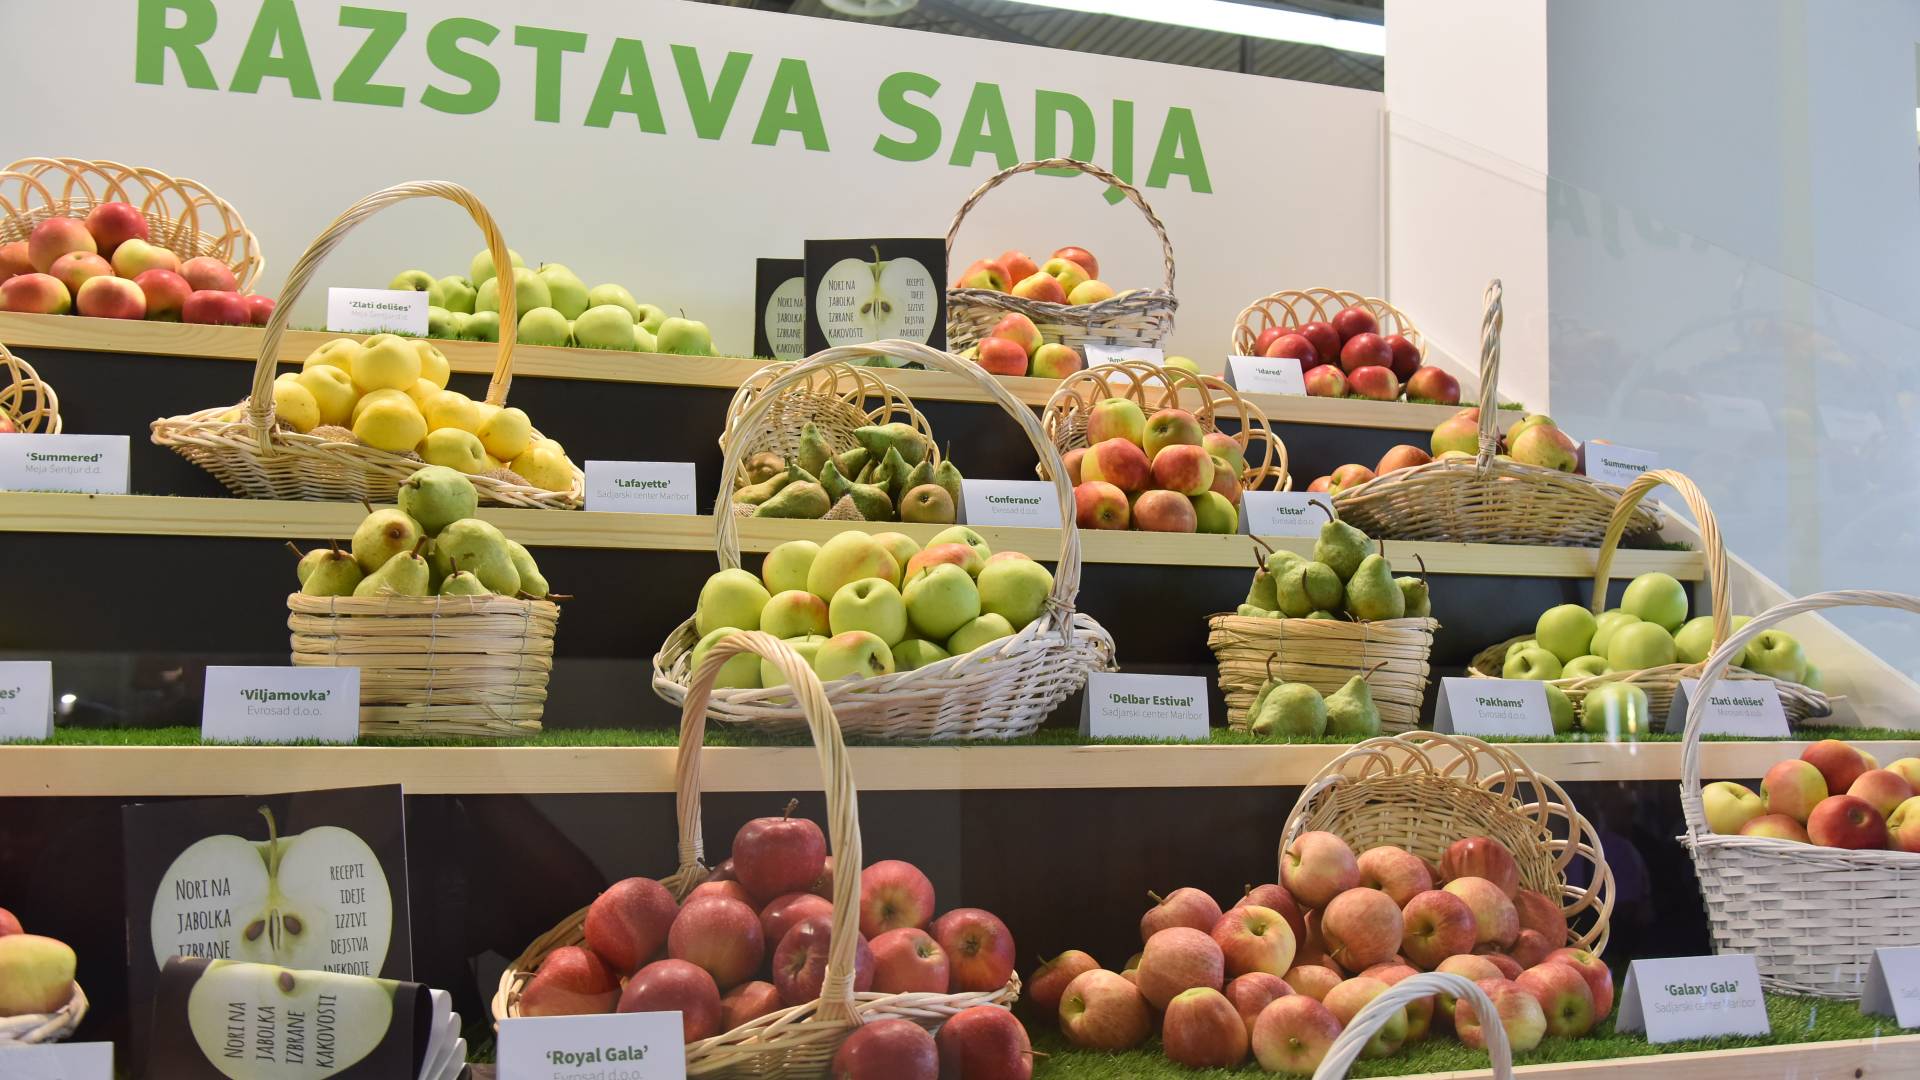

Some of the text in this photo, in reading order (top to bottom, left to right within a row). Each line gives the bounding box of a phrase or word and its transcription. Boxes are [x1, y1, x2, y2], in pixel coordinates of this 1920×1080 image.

[135, 0, 1213, 206] RAZSTAVA SADJA
[828, 296, 855, 308] JABOLKA
[828, 312, 854, 322] IZBRANE
[828, 327, 863, 339] KAKOVOSTI
[776, 343, 804, 354] KAKOVOS
[329, 863, 365, 881] RECEPTI
[176, 877, 231, 900] NORI NA
[340, 887, 366, 904] IDEJE
[177, 908, 232, 934] JABOLKA
[335, 911, 367, 929] IZZIVI
[331, 936, 369, 954] DEJSTVA
[224, 1002, 247, 1059] NORI NA
[255, 1005, 276, 1063] JABOLKA
[285, 1009, 305, 1065] IZBRANE
[316, 994, 337, 1068] KAKOVOSTI
